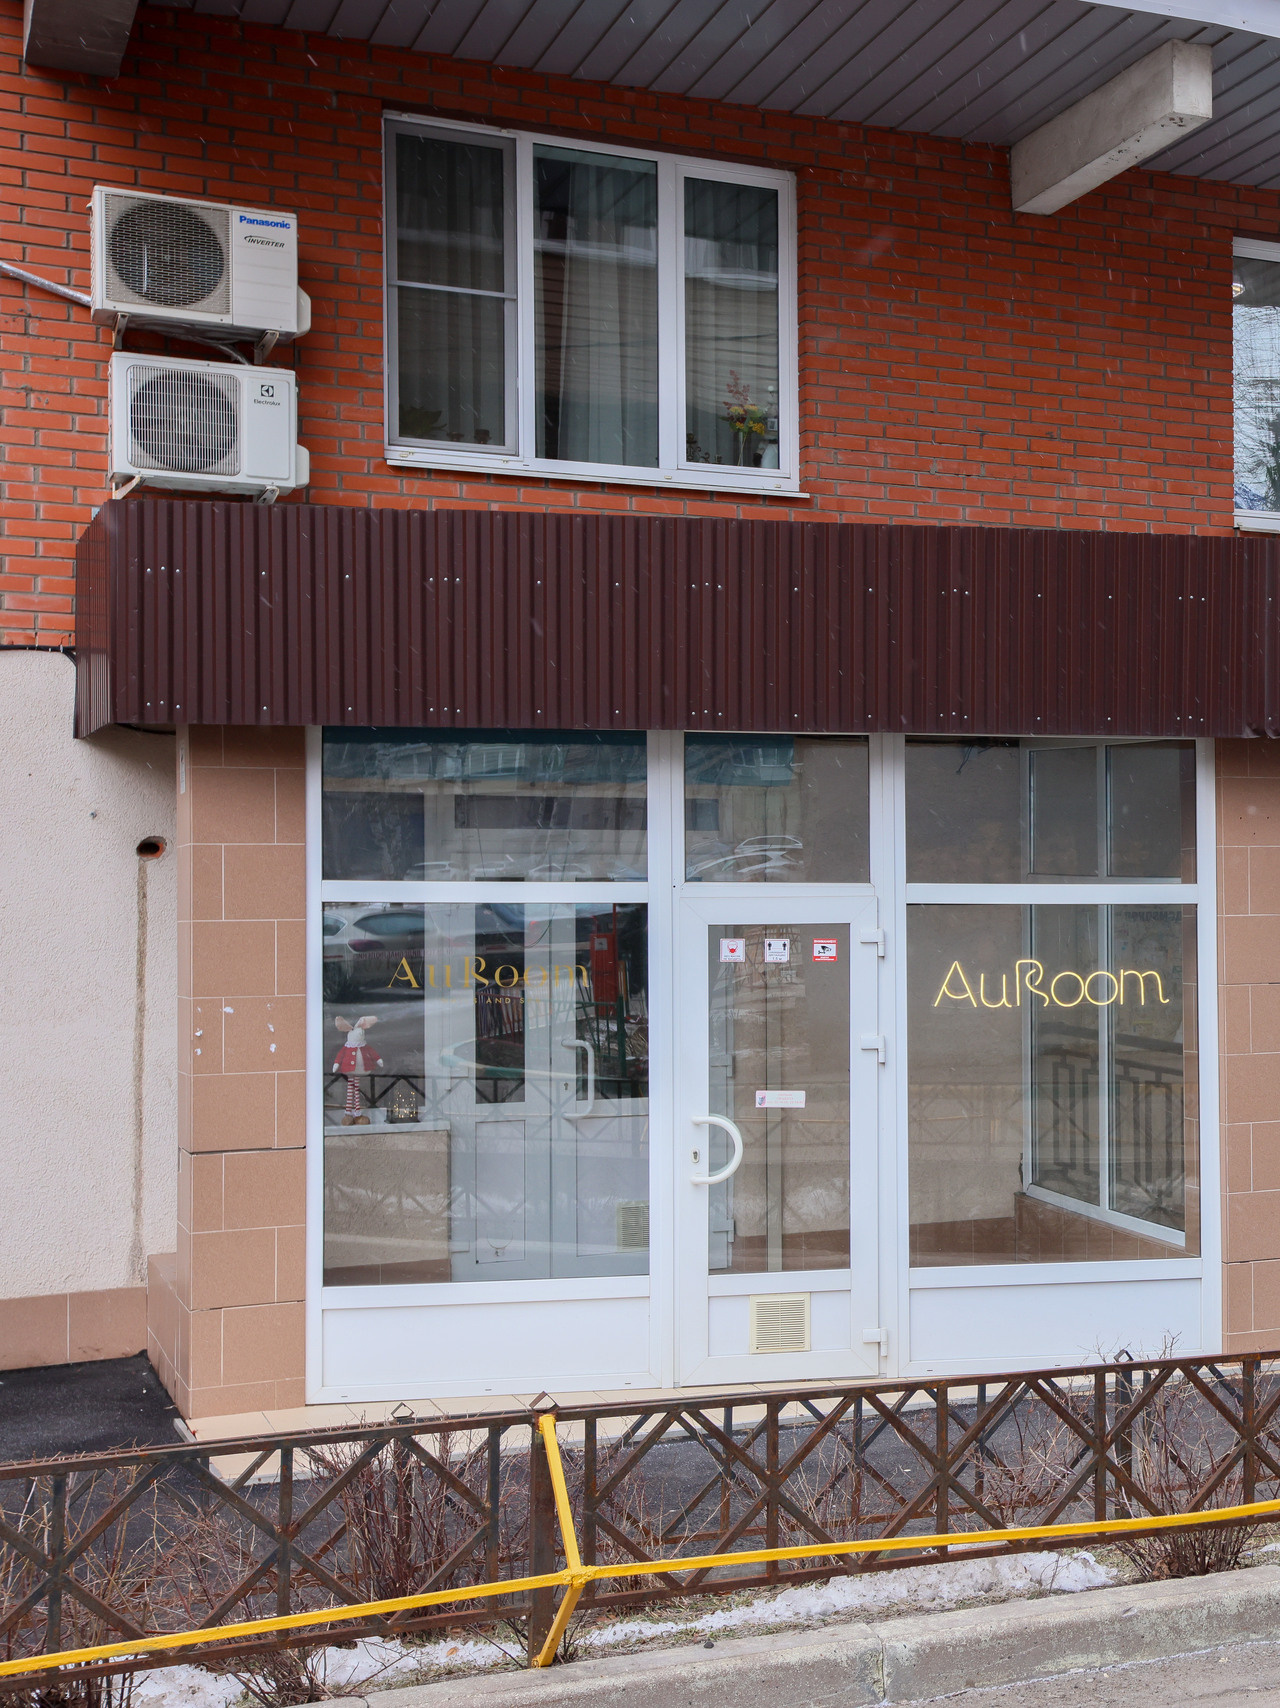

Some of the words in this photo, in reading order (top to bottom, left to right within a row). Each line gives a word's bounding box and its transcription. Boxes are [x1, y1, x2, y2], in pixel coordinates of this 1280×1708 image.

[239, 215, 291, 229] Panasonic
[247, 237, 285, 248] INVERTER
[253, 398, 281, 406] Electrolux
[387, 956, 591, 989] AuRoom
[934, 959, 1170, 1008] AuRoom
[485, 997, 511, 1005] AND
